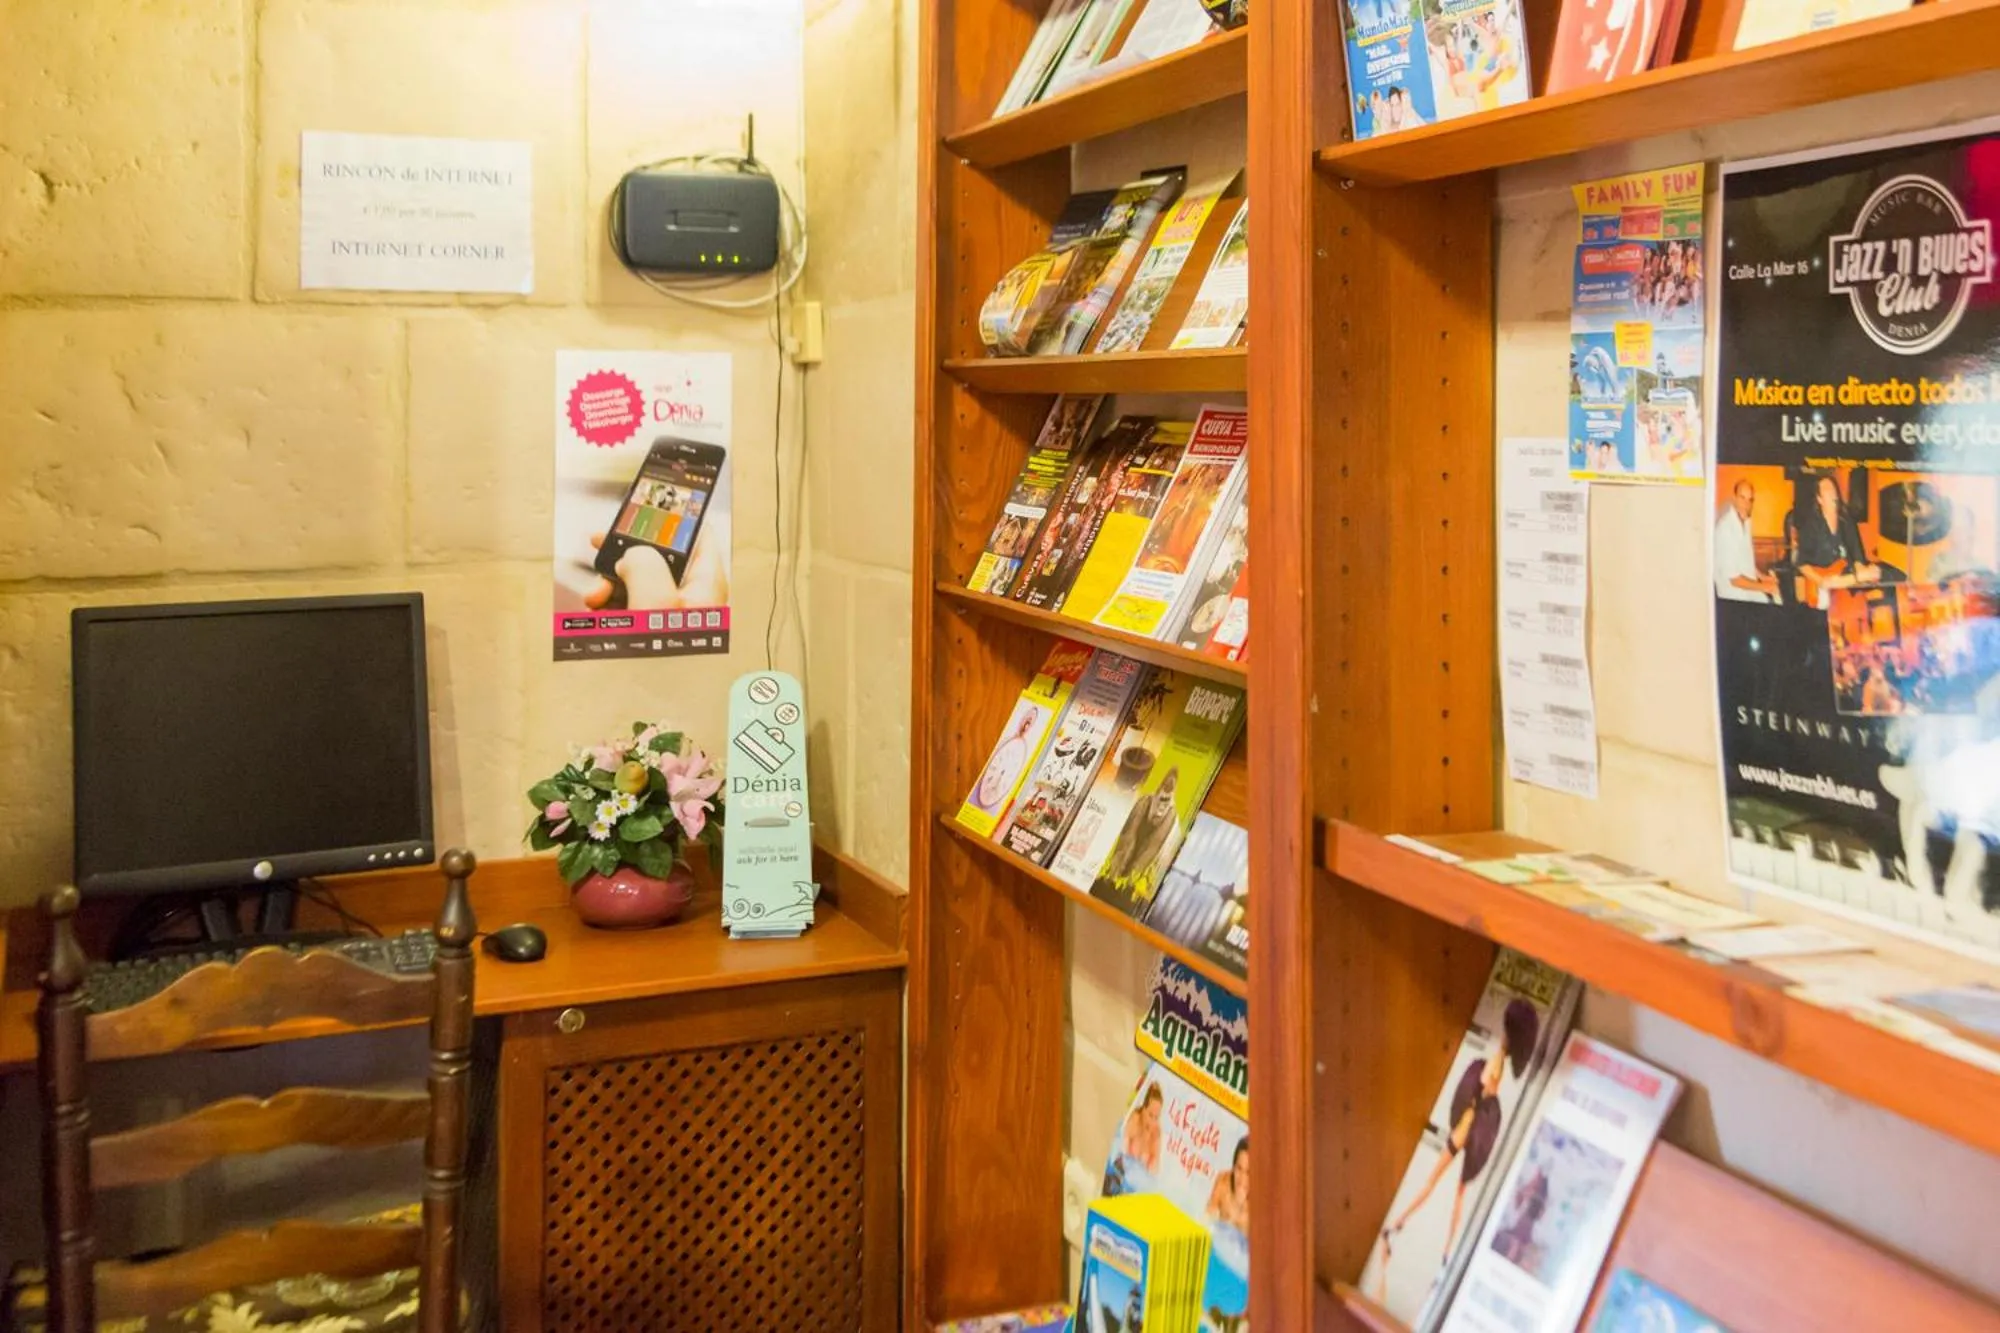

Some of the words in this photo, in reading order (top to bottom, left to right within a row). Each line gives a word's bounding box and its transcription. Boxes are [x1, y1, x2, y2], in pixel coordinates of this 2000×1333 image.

[401, 166, 419, 180] de
[425, 167, 512, 186] INTERNET
[1586, 179, 1652, 207] FAMILY
[1662, 170, 1698, 193] FUN
[1868, 191, 1910, 227] MUSIC
[331, 240, 424, 258] INTERNET
[430, 244, 506, 261] CORNER
[1728, 265, 1755, 281] Calle
[1757, 264, 1772, 278] La
[1773, 262, 1795, 276] Mar
[1797, 260, 1809, 274] 16
[1875, 270, 1941, 317] Club
[1887, 322, 1929, 336] DENIA
[1734, 376, 1804, 406] Música
[1807, 382, 1835, 406] en
[1838, 375, 1916, 406] directo
[1919, 373, 1985, 406] todos
[1781, 413, 1826, 443] Live
[1832, 418, 1896, 443] music
[1737, 705, 1870, 747] STEINWAY
[732, 773, 802, 795] Dénia
[754, 854, 768, 867] for
[779, 853, 799, 864] here
[1140, 990, 1249, 1096] Aqualan
